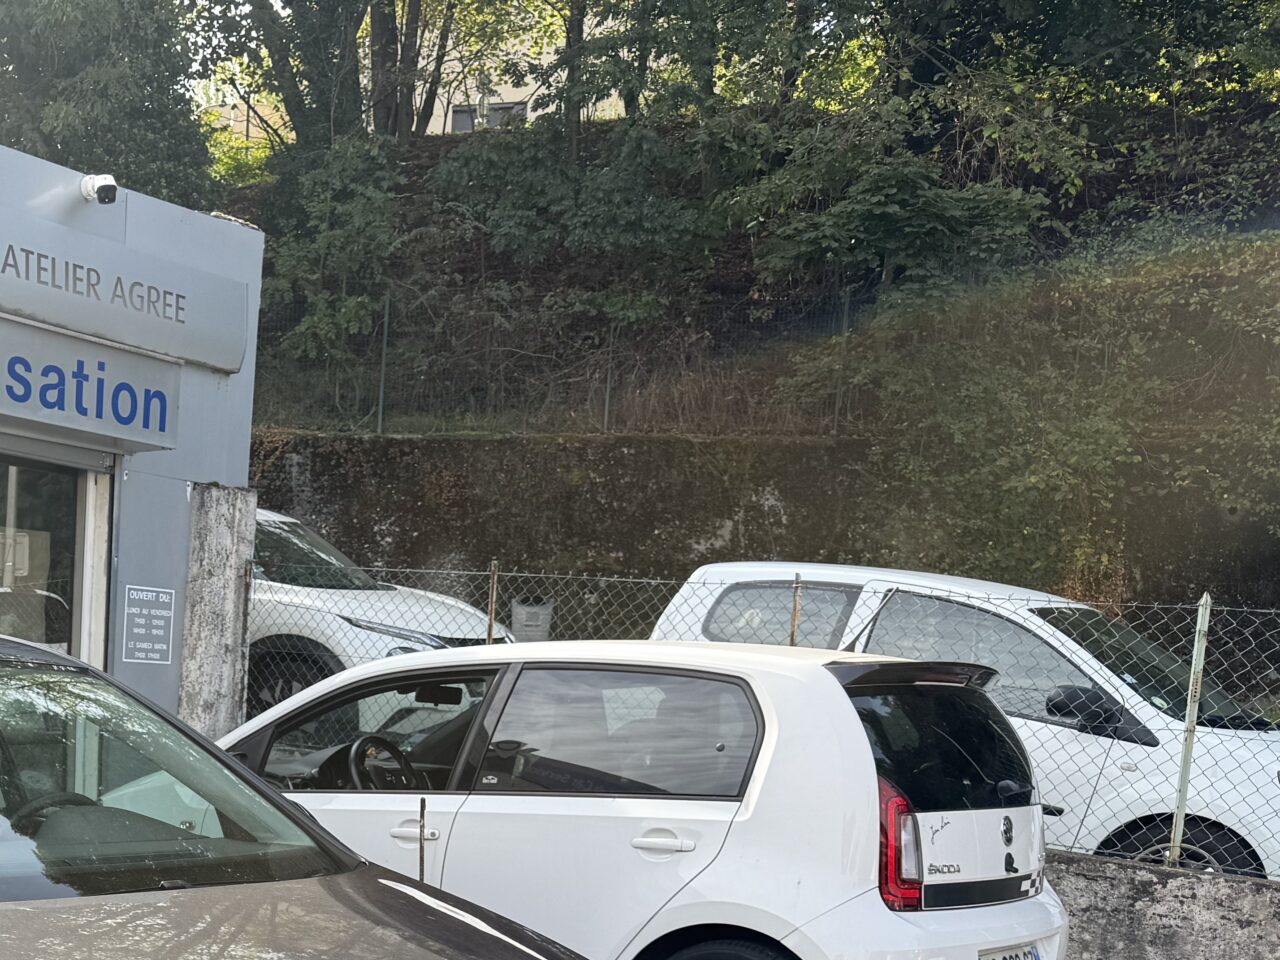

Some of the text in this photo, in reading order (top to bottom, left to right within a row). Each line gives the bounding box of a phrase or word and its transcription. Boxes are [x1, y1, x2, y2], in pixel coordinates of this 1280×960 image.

[1, 244, 186, 325] ATELIER AGREE
[130, 590, 156, 600] OUVERT
